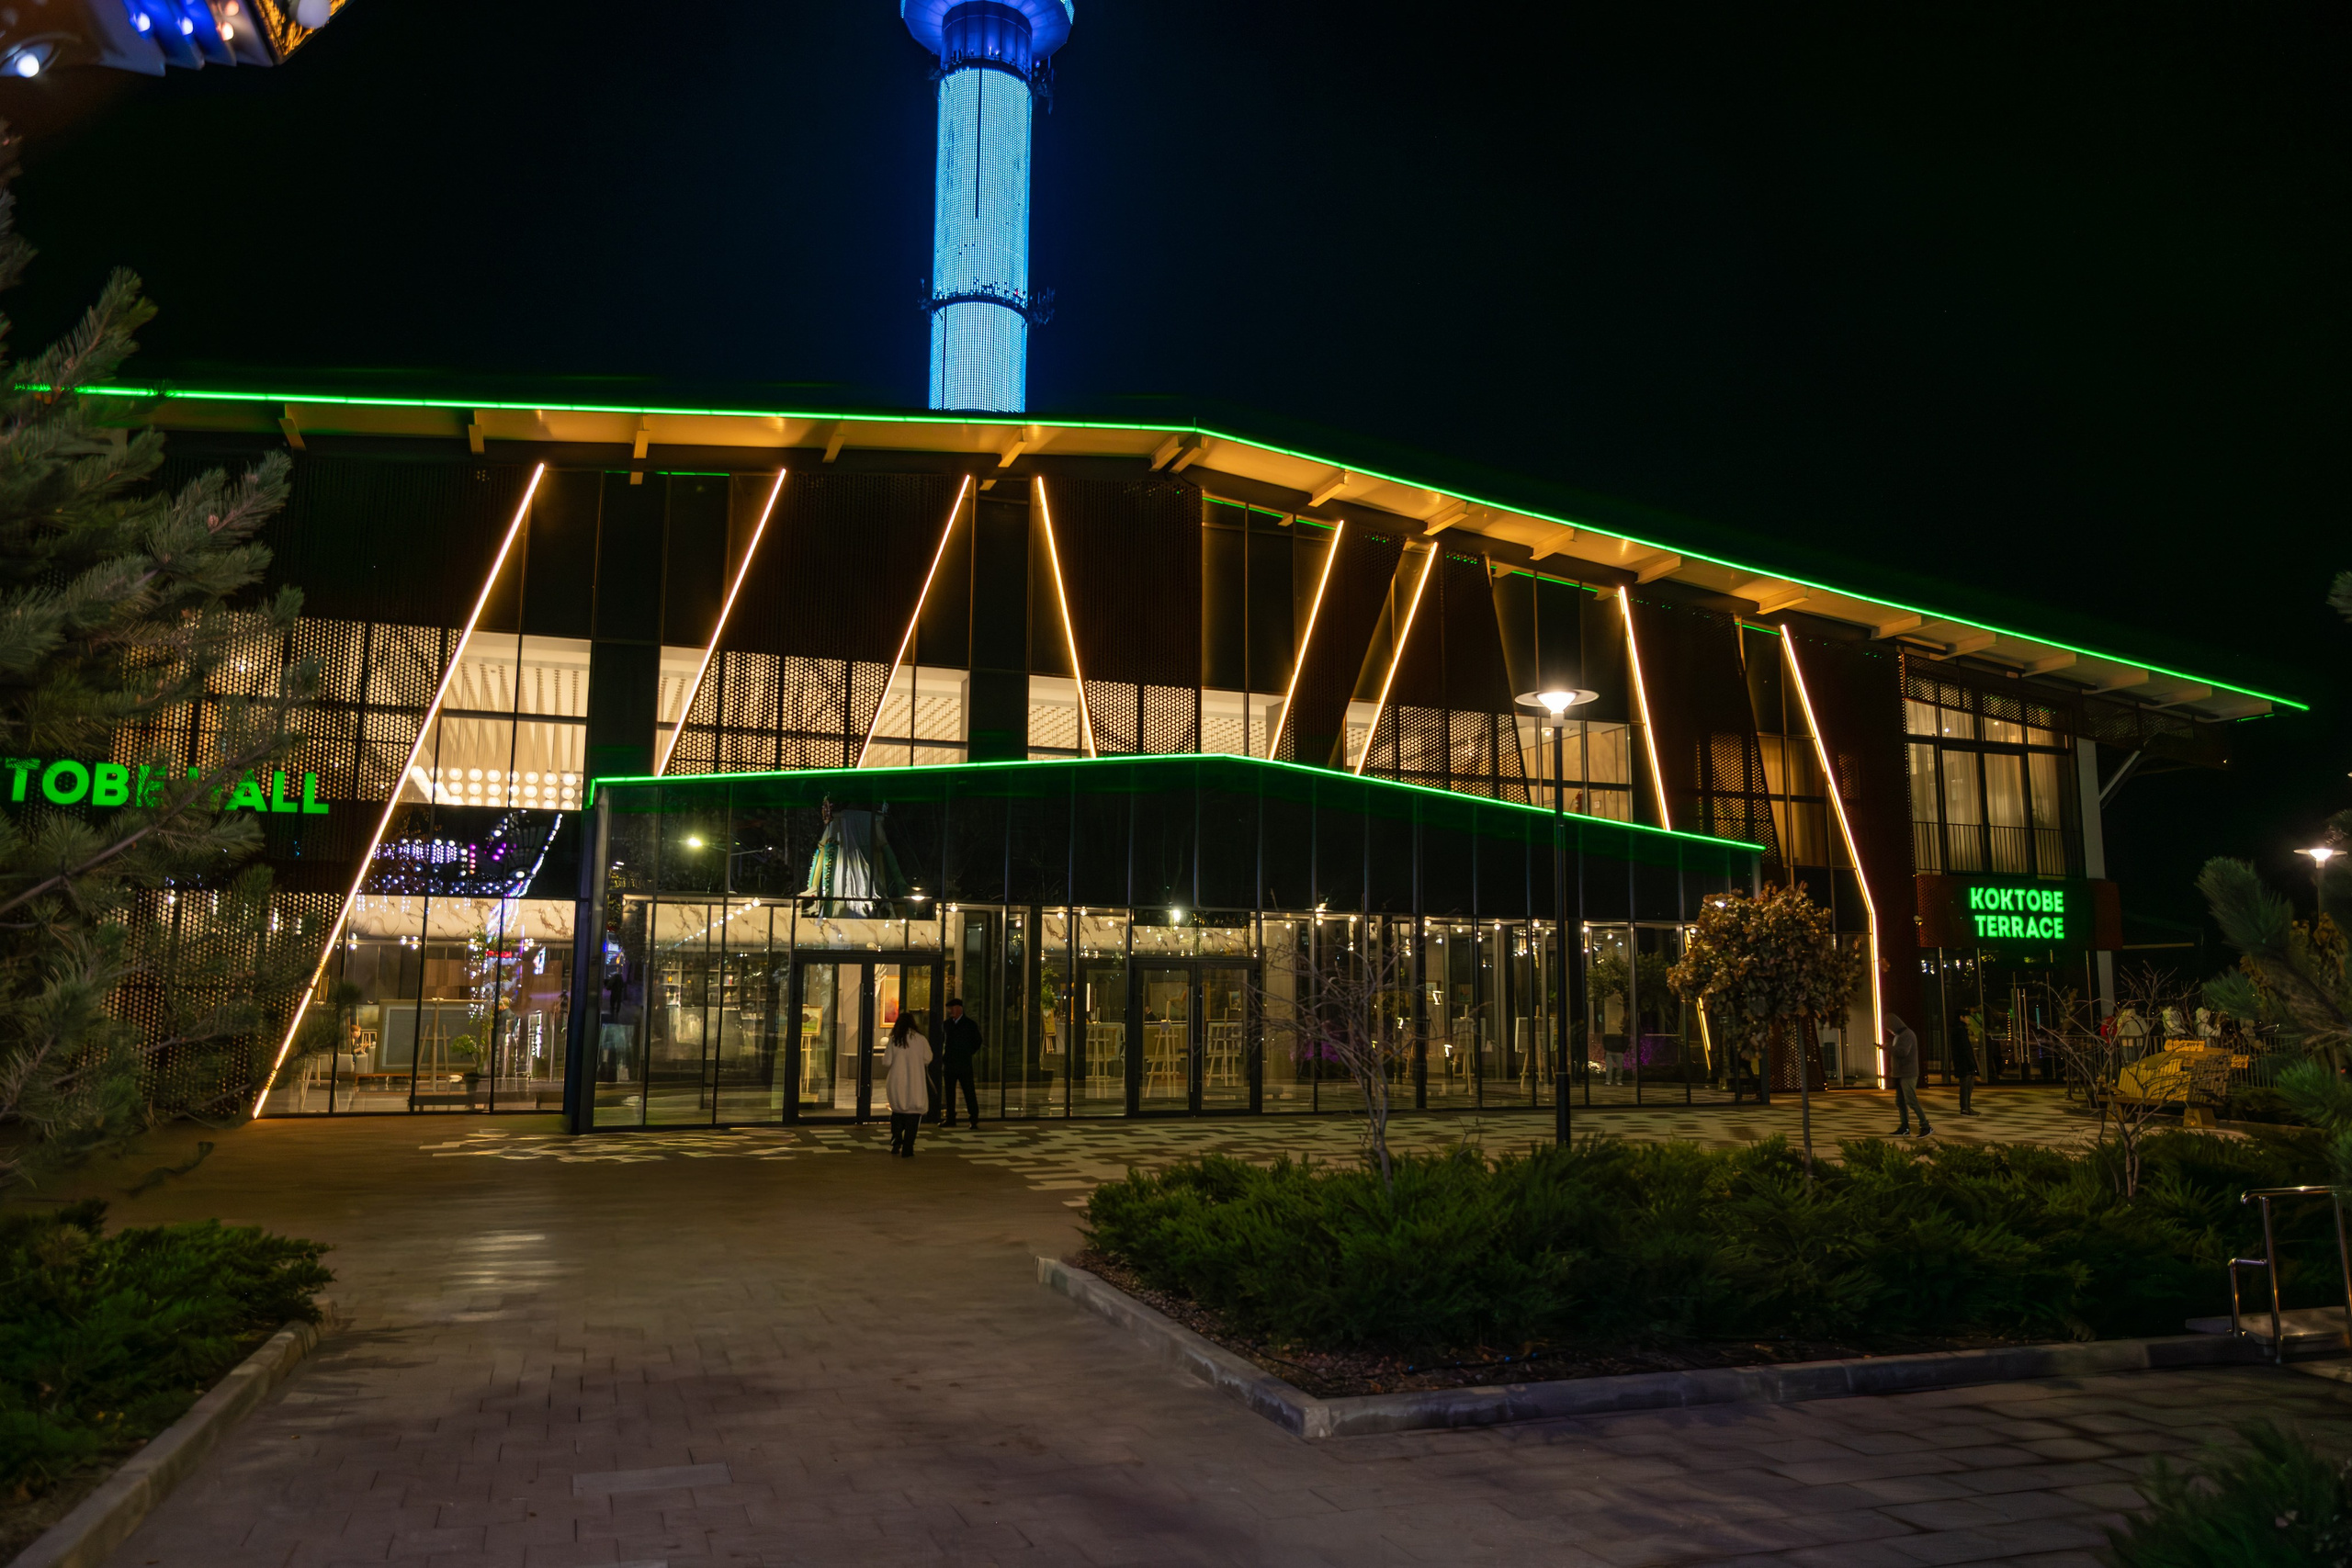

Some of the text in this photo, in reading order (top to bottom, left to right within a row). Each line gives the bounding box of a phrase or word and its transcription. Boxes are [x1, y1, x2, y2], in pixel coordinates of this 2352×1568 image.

[187, 765, 329, 815] ALL
[1970, 886, 2064, 913] KOKTOBE
[1974, 914, 2064, 939] TERRACE
